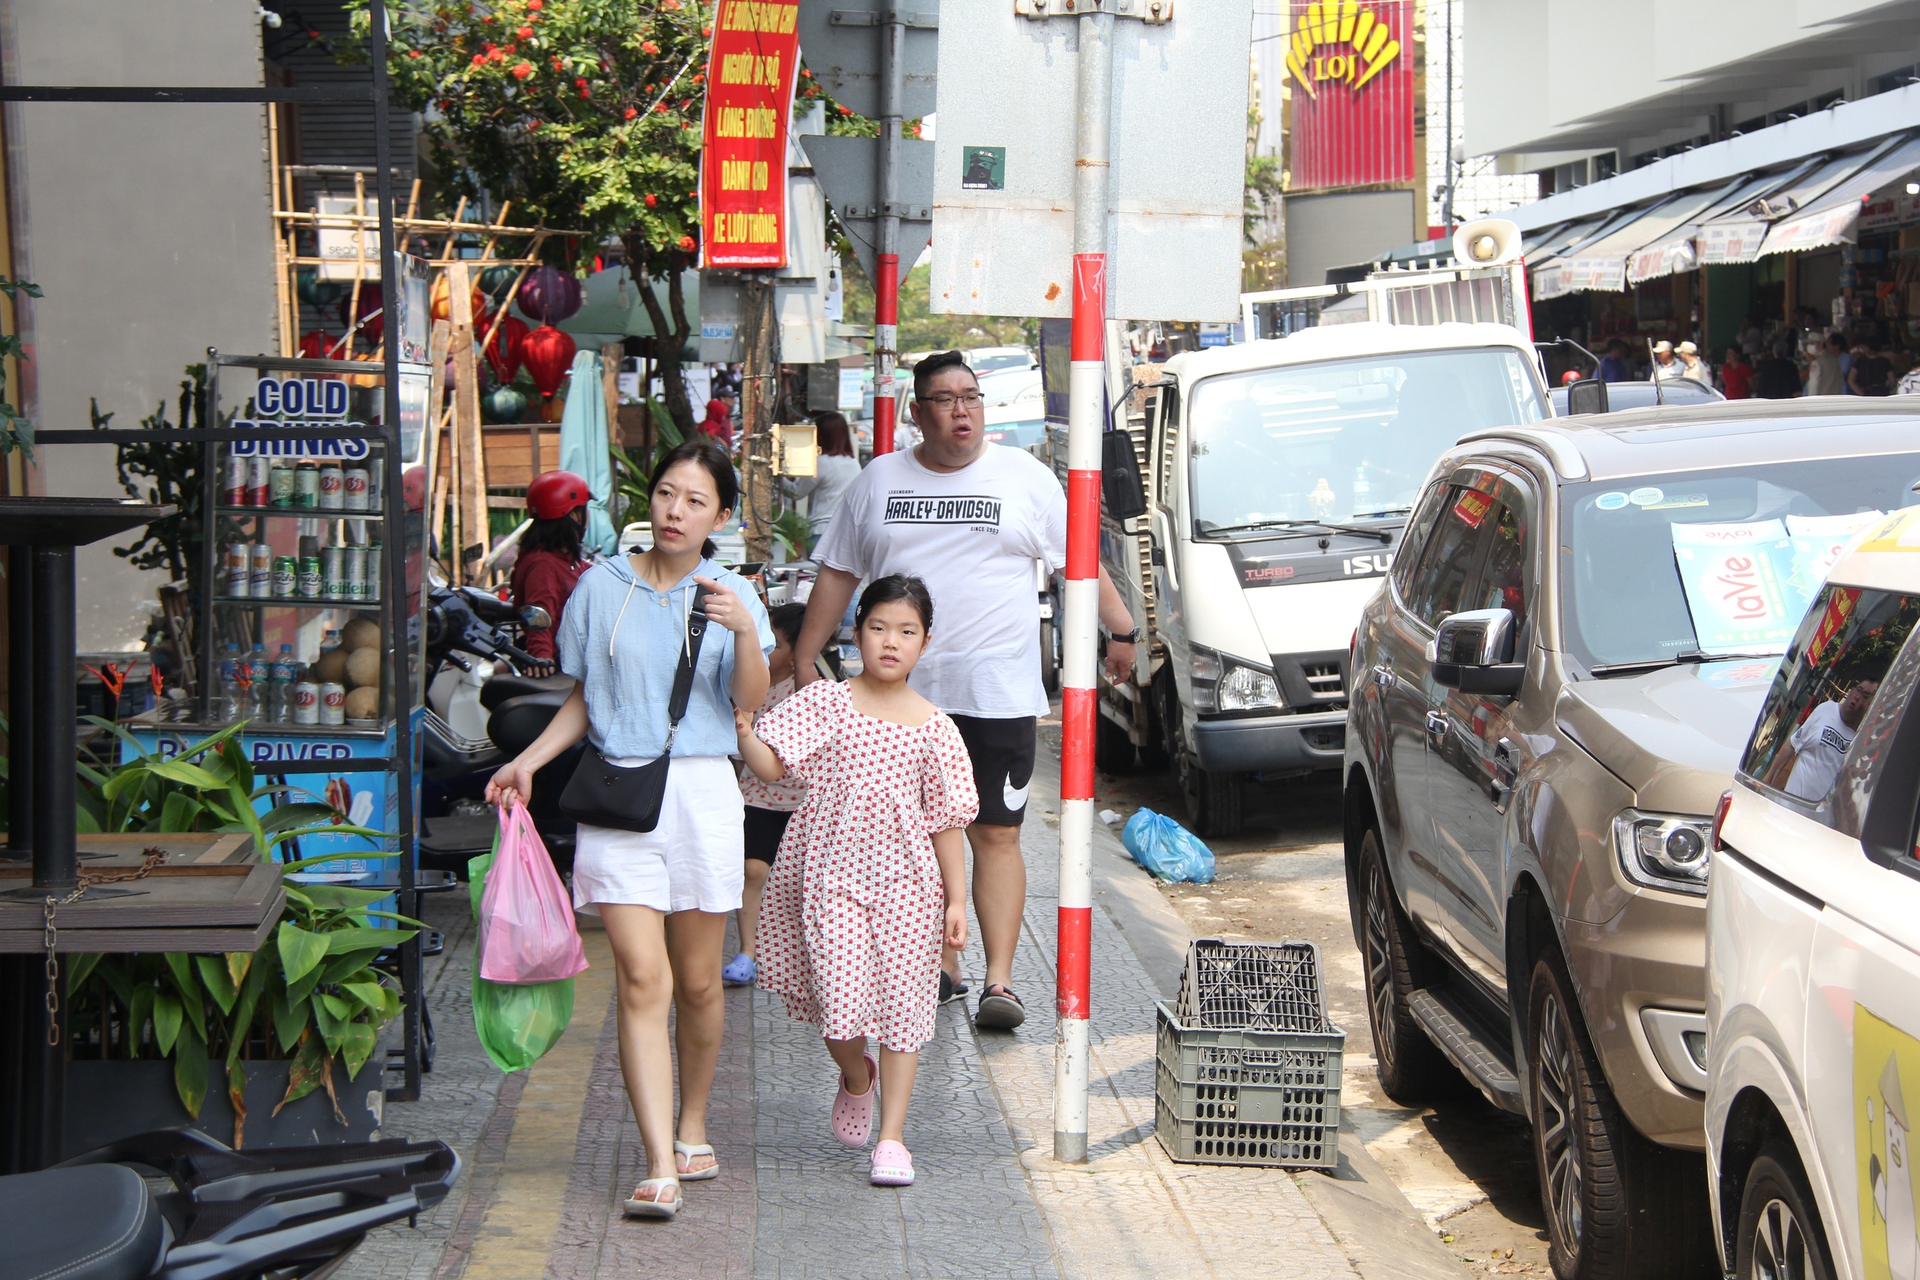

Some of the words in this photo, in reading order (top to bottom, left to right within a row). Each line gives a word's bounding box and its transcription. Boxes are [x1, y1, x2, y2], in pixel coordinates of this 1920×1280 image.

[779, 5, 799, 34] CHO
[721, 47, 754, 85] NGƯỜI
[1314, 54, 1357, 85] LOJ
[717, 100, 745, 138] LÒNG
[746, 101, 776, 138] ĐƯỜNG
[722, 154, 750, 191] DÀNH
[752, 161, 768, 191] CHO
[714, 213, 726, 243] XE
[727, 210, 748, 243] LƯU
[748, 207, 778, 243] THÔNG
[257, 378, 348, 416] COLD
[233, 421, 369, 459] DRINKS
[885, 500, 1001, 521] HARLEY-DAVIDSON
[1245, 566, 1294, 578] TURBO
[1717, 556, 1767, 620] laVie
